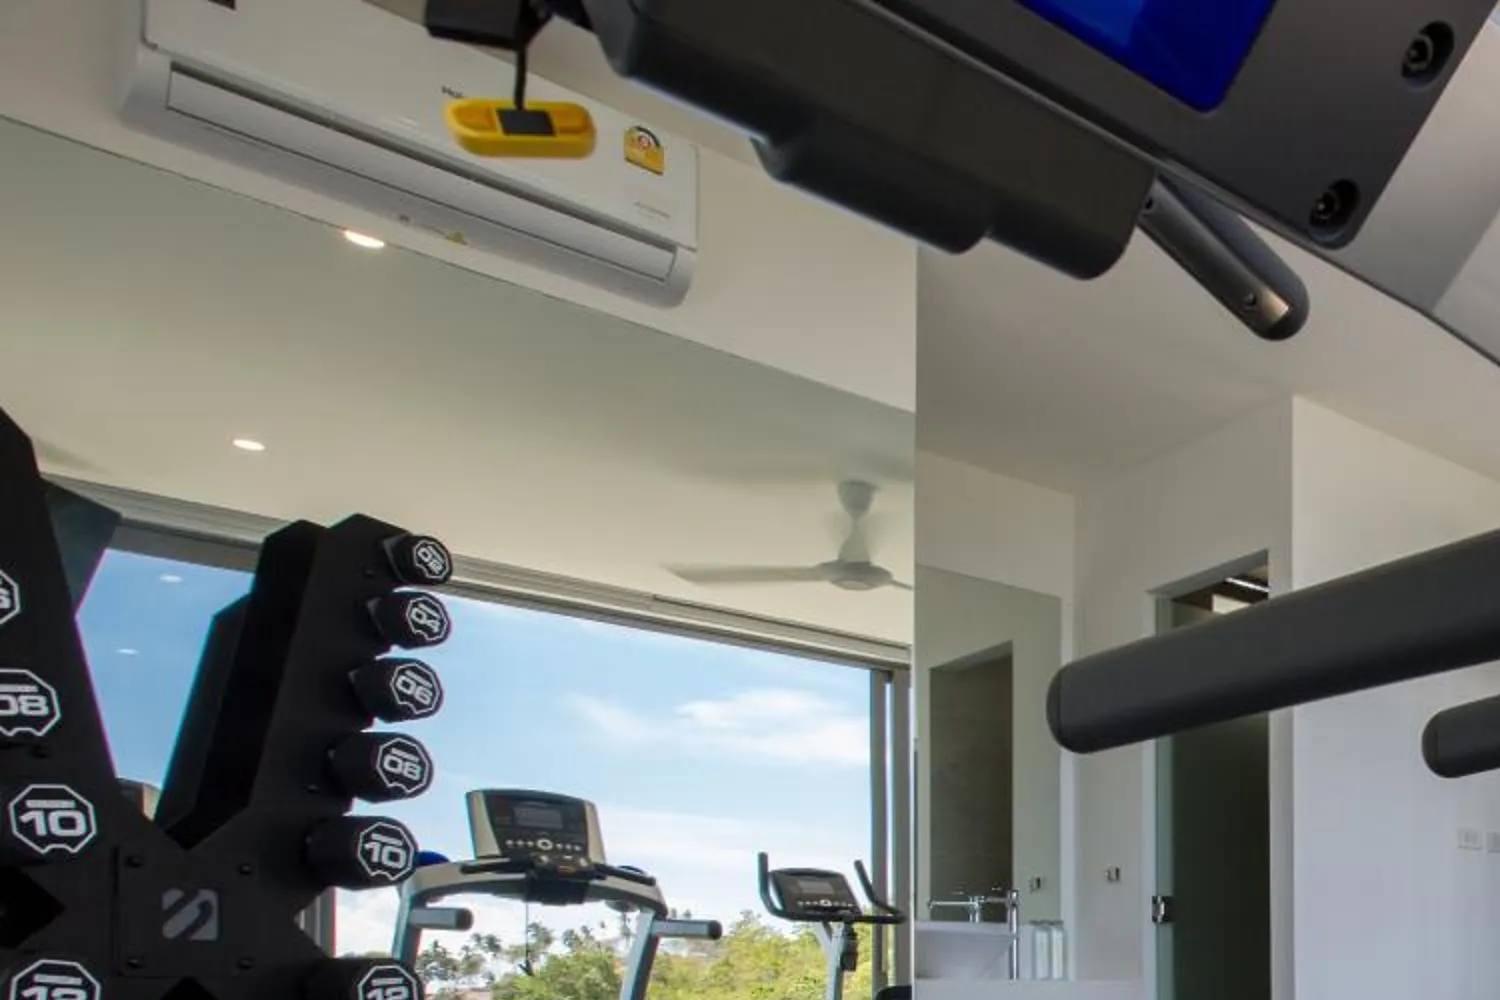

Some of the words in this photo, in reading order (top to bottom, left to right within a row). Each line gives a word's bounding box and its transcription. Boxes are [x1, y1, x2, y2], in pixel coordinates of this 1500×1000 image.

[410, 606, 441, 633] 04
[395, 674, 433, 705] 06
[0, 694, 49, 716] 08
[383, 753, 422, 781] 08
[19, 810, 86, 837] 10
[363, 840, 407, 870] 10
